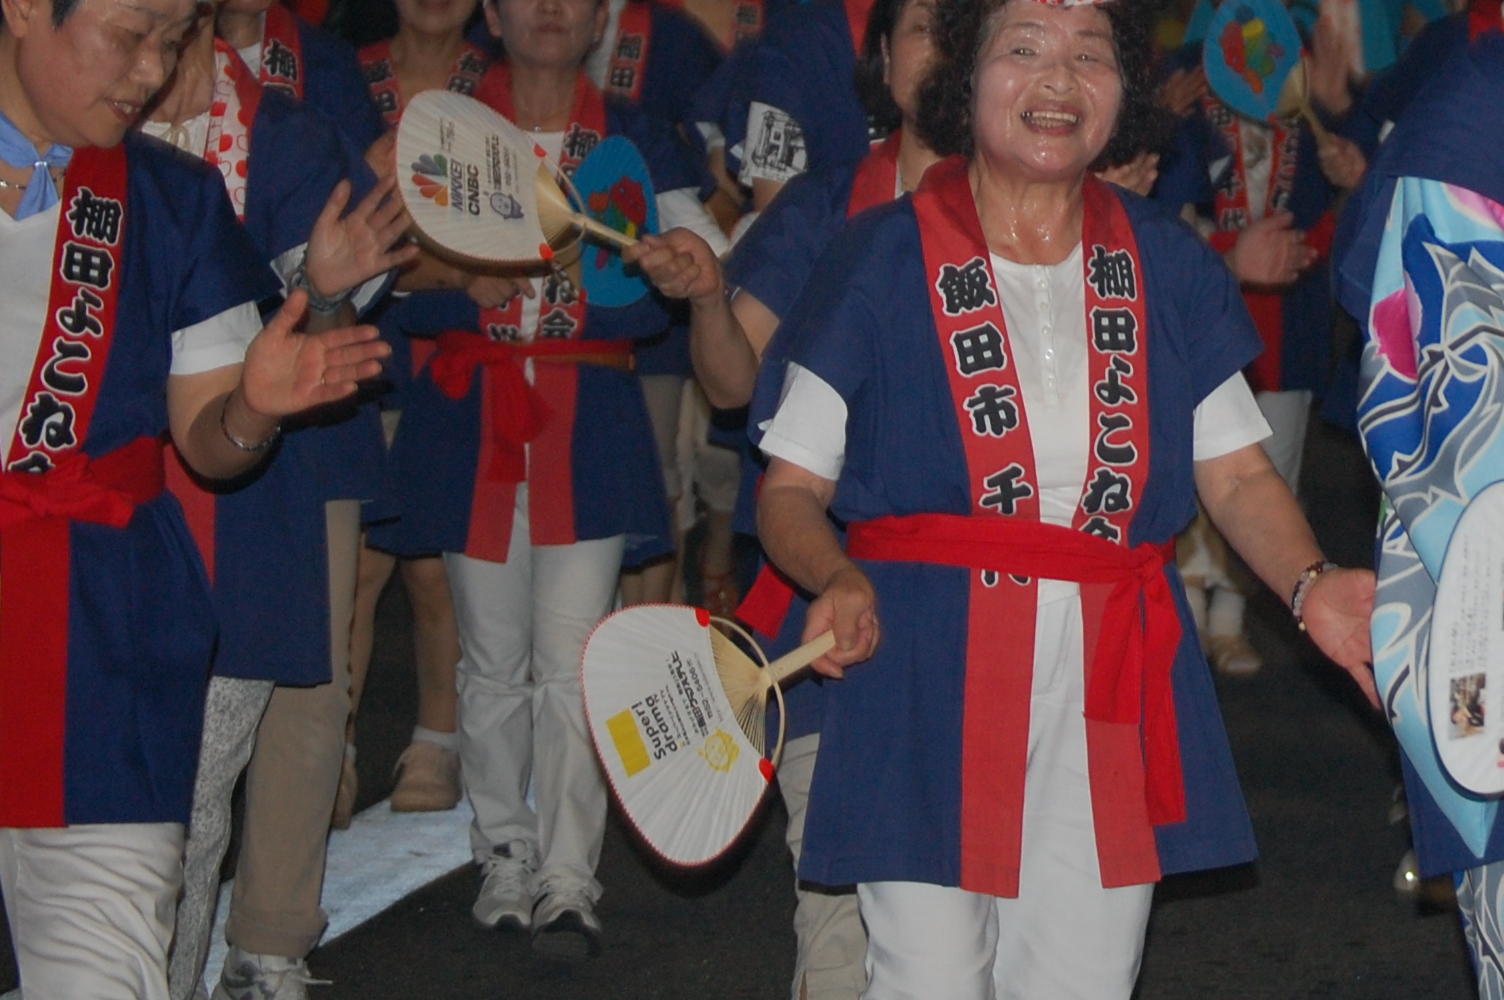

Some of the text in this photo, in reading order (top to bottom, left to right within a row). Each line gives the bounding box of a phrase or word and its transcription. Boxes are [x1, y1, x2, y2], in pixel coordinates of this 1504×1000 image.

[450, 158, 463, 212] NIKKEI
[466, 163, 480, 216] CNBC
[631, 701, 667, 761] Super!
[644, 695, 679, 753] drama
